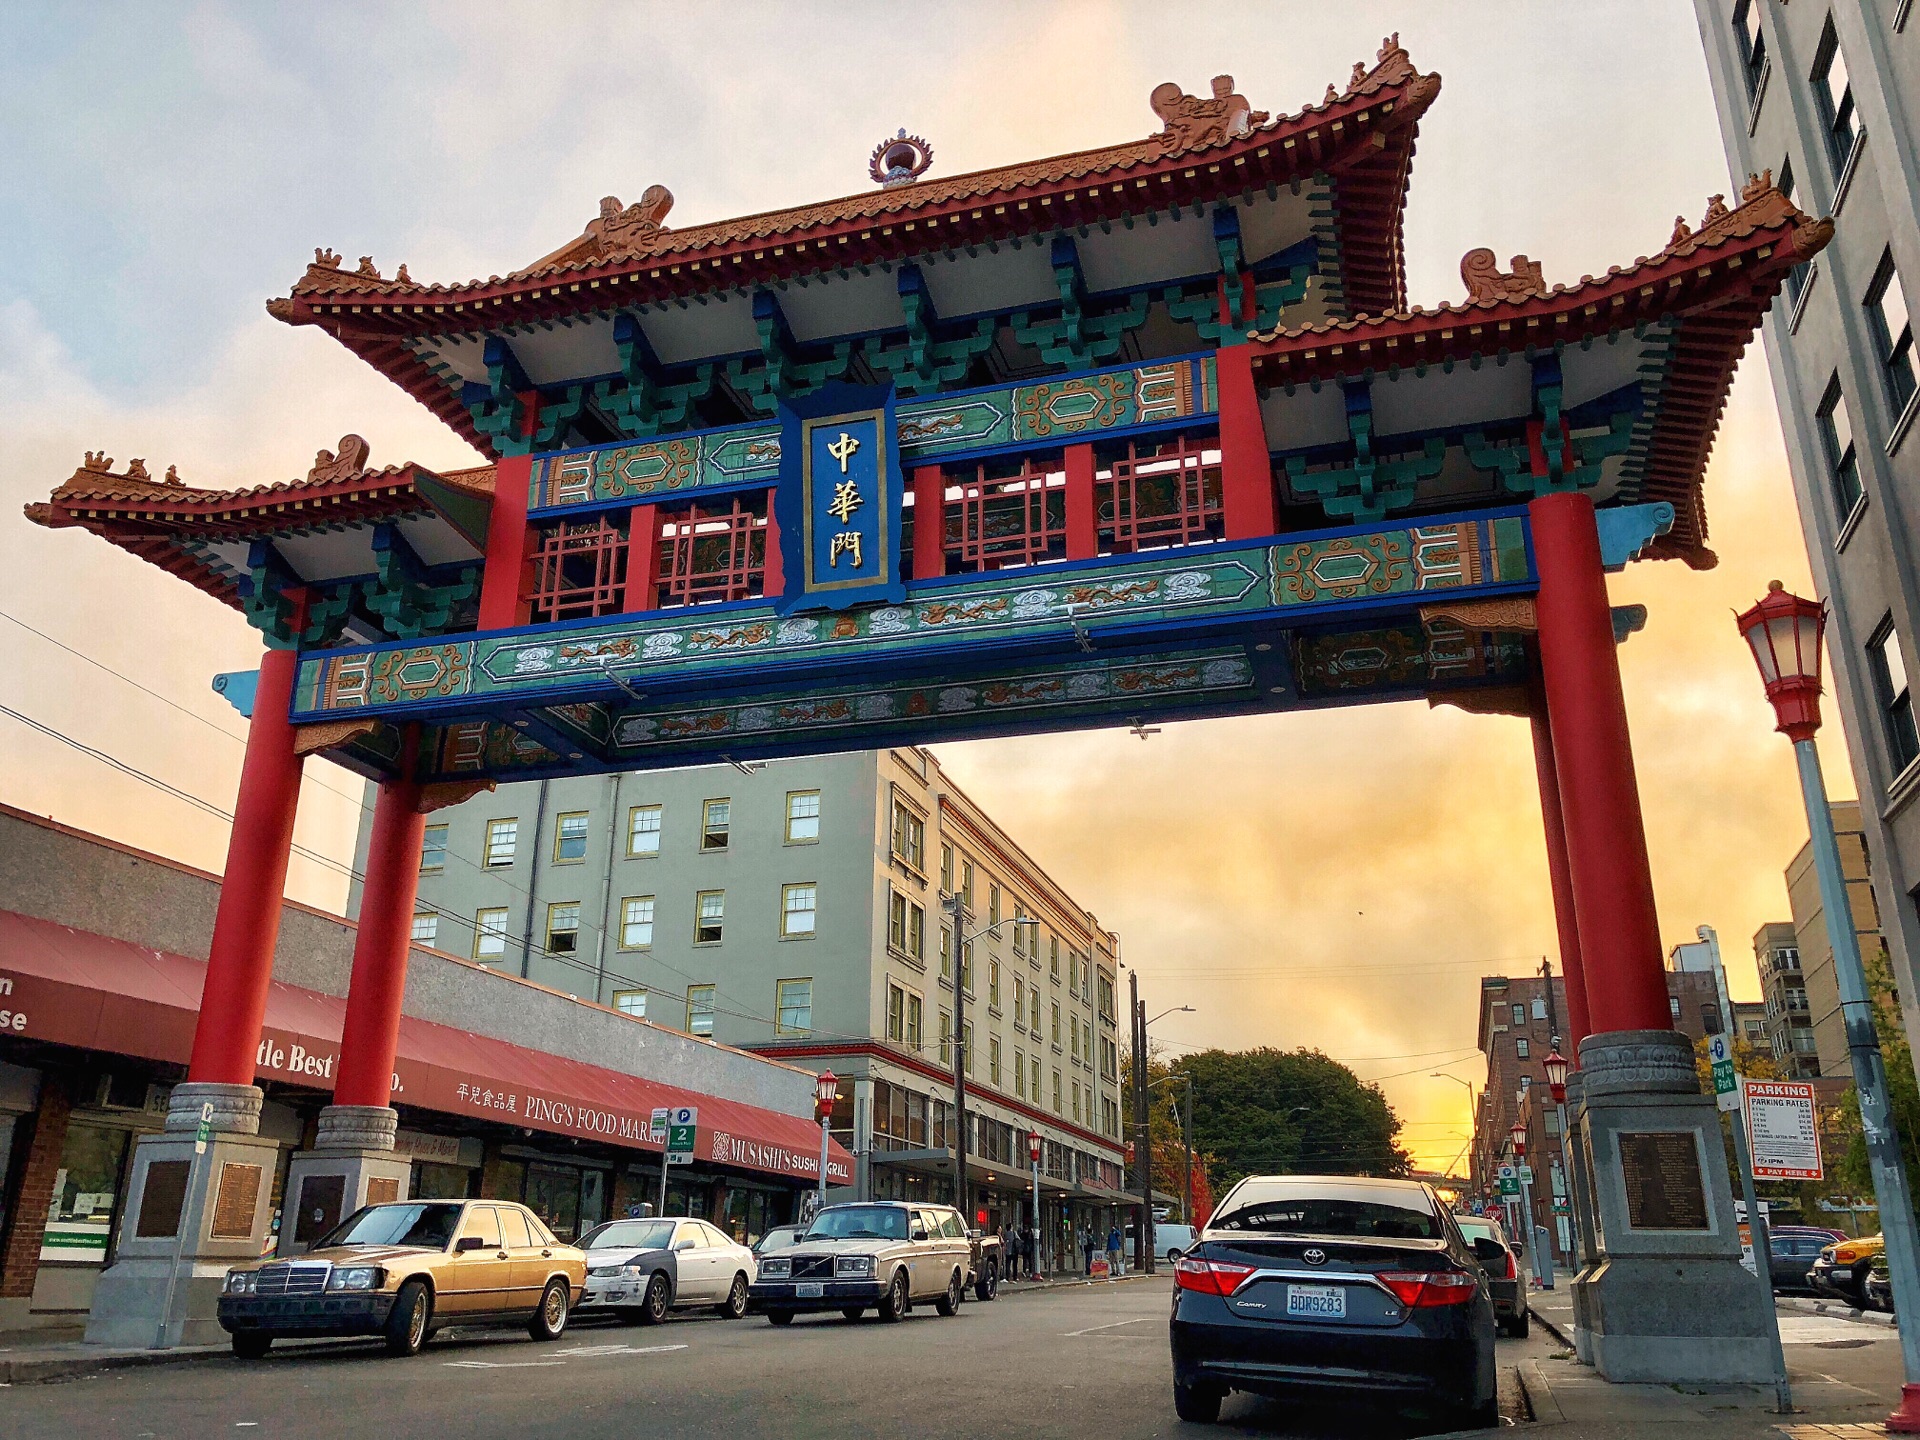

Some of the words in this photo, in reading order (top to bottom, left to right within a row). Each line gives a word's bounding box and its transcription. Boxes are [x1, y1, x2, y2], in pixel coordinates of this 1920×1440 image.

[827, 432, 864, 568] 中華門
[287, 1044, 333, 1078] Best
[1713, 1066, 1725, 1077] Pay
[1725, 1064, 1733, 1074] to
[1718, 1077, 1733, 1090] Park
[1748, 1084, 1809, 1096] PARKING
[457, 1083, 517, 1113] 平兒食品屋
[1751, 1098, 1784, 1107] PARKING
[1786, 1100, 1810, 1108] RATES
[524, 1095, 574, 1127] PING'S
[576, 1107, 617, 1135] FOOD
[677, 1128, 687, 1141] 2
[729, 1138, 791, 1171] MUSASHI'S
[792, 1154, 819, 1172] SUSHI
[827, 1161, 849, 1178] GRILL
[1767, 1168, 1783, 1176] PAY
[1785, 1169, 1808, 1177] HERE
[1506, 1180, 1512, 1188] 2
[1485, 1210, 1501, 1218] STOP
[1290, 1295, 1342, 1313] BDR9283
